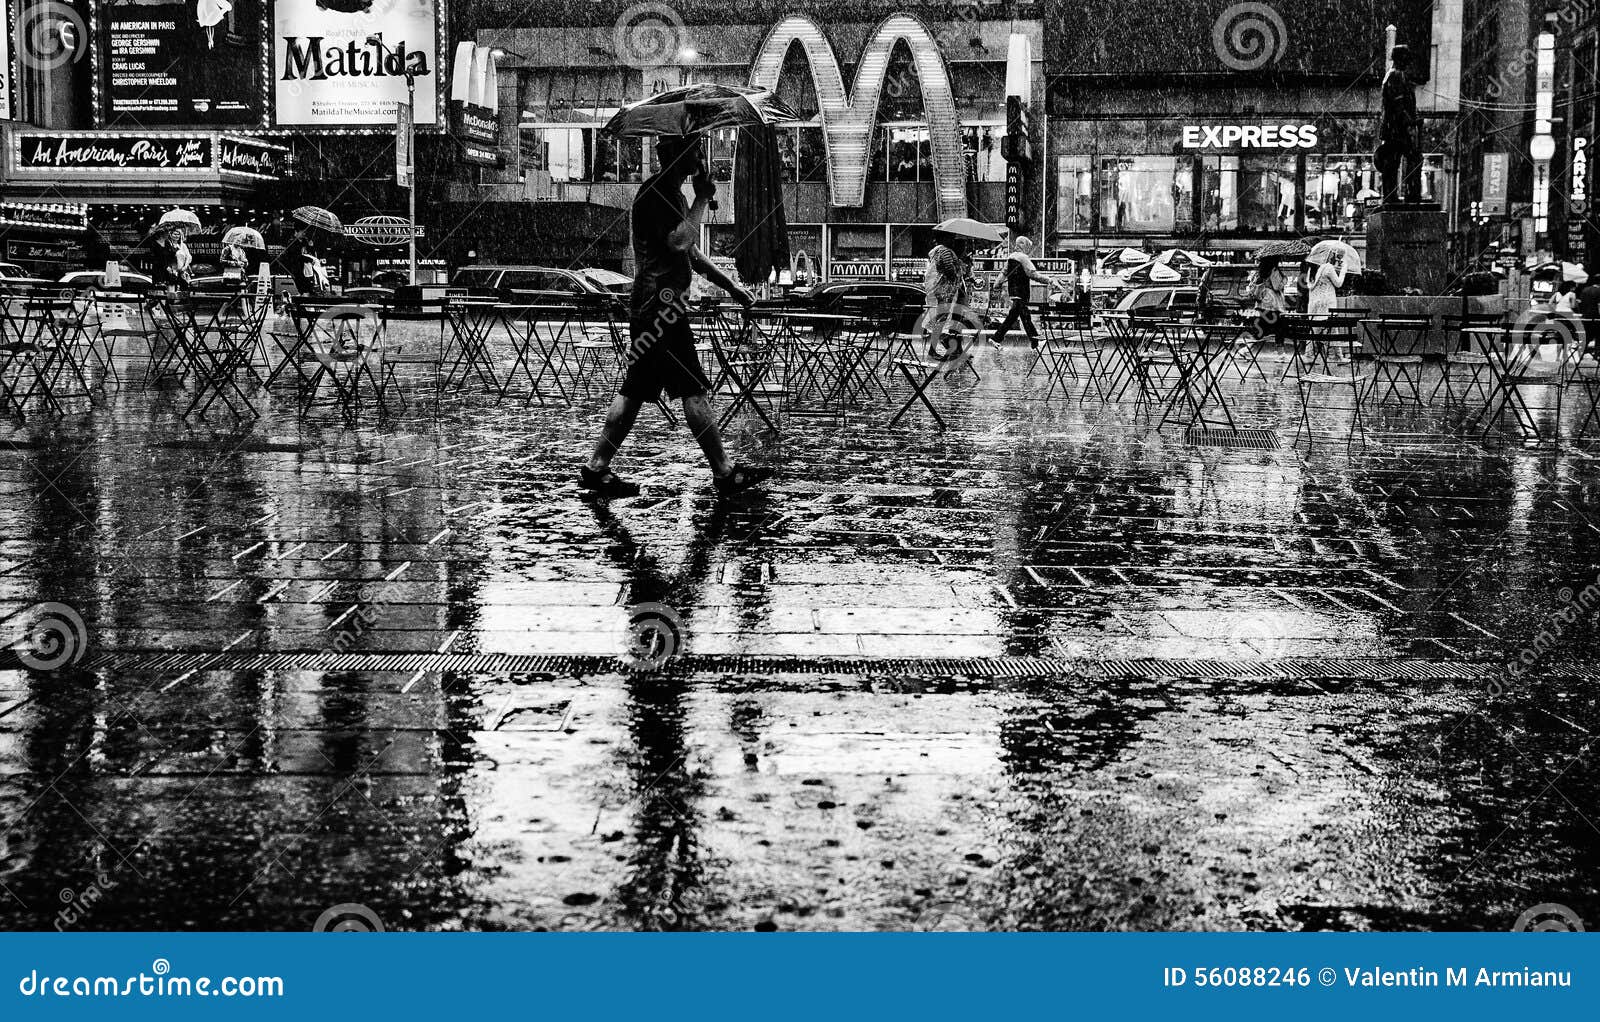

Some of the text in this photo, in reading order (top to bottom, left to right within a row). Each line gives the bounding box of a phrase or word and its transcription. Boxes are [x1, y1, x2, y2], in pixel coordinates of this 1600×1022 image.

[111, 21, 119, 30] AN
[120, 21, 150, 30] AMERICAN
[158, 21, 175, 30] PARIS
[280, 32, 431, 80] Matilda
[112, 62, 145, 70] CRAIG LUCAS
[112, 78, 177, 86] CHRISTOPHER WHEELDON
[463, 113, 499, 131] McDonald's
[1182, 124, 1318, 148] EXPRESS
[31, 140, 52, 164] An
[54, 138, 127, 167] American
[131, 140, 171, 167] Paris
[344, 226, 375, 234] MONEY
